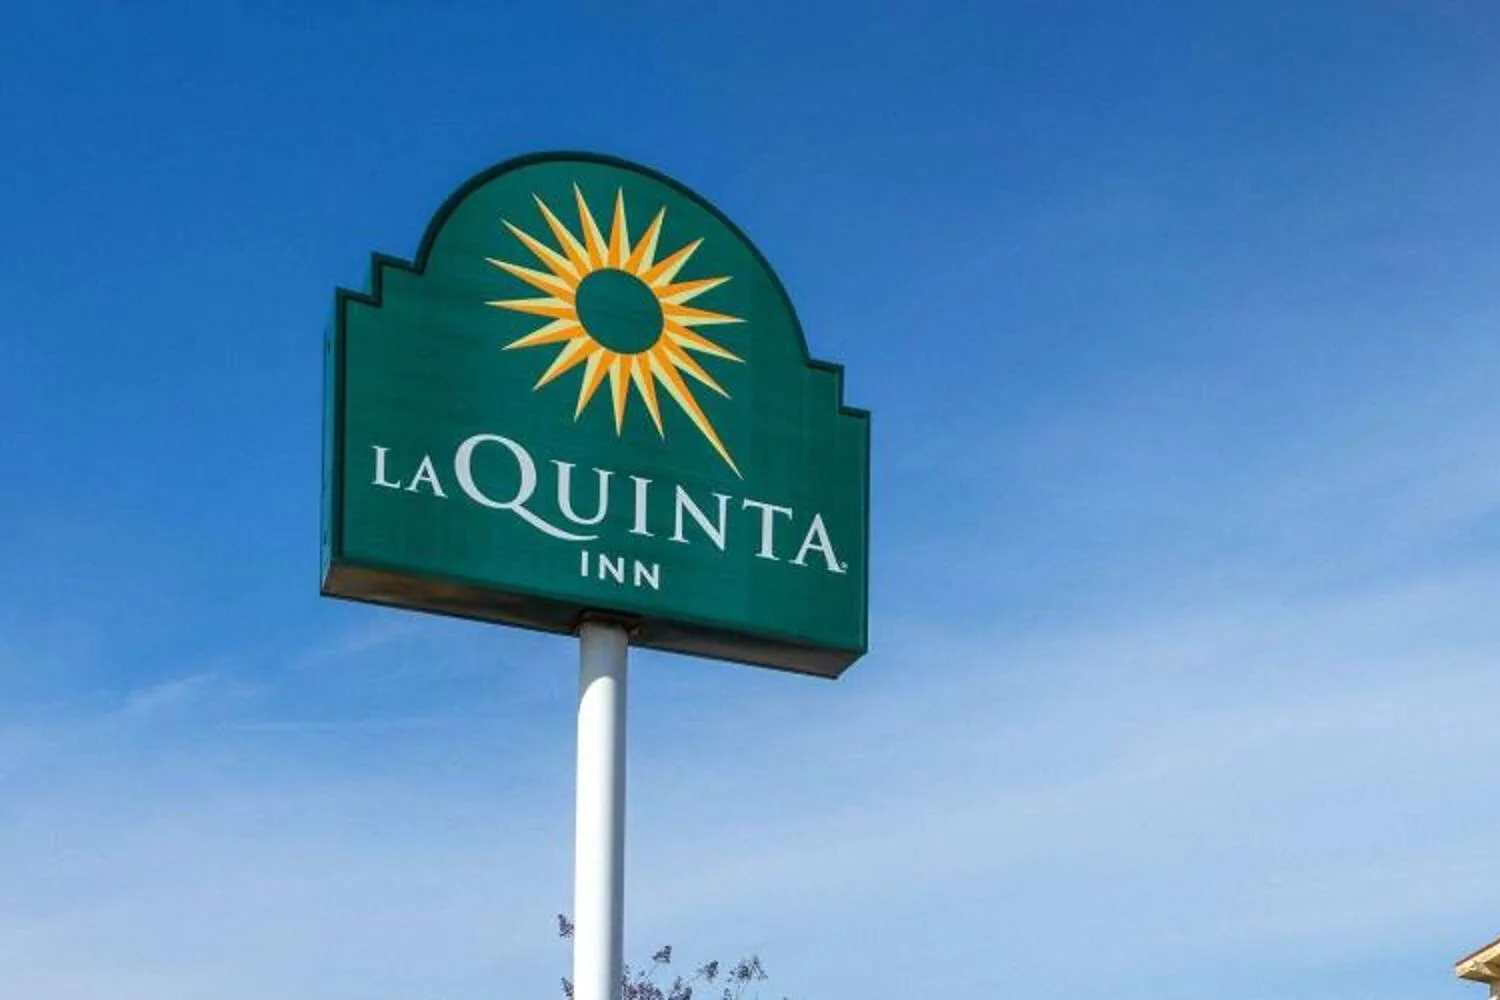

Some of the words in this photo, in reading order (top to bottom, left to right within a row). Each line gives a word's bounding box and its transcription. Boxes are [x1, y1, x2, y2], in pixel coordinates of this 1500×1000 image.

[372, 445, 448, 498] LA
[454, 433, 848, 574] QUINTA
[581, 550, 660, 590] INN
